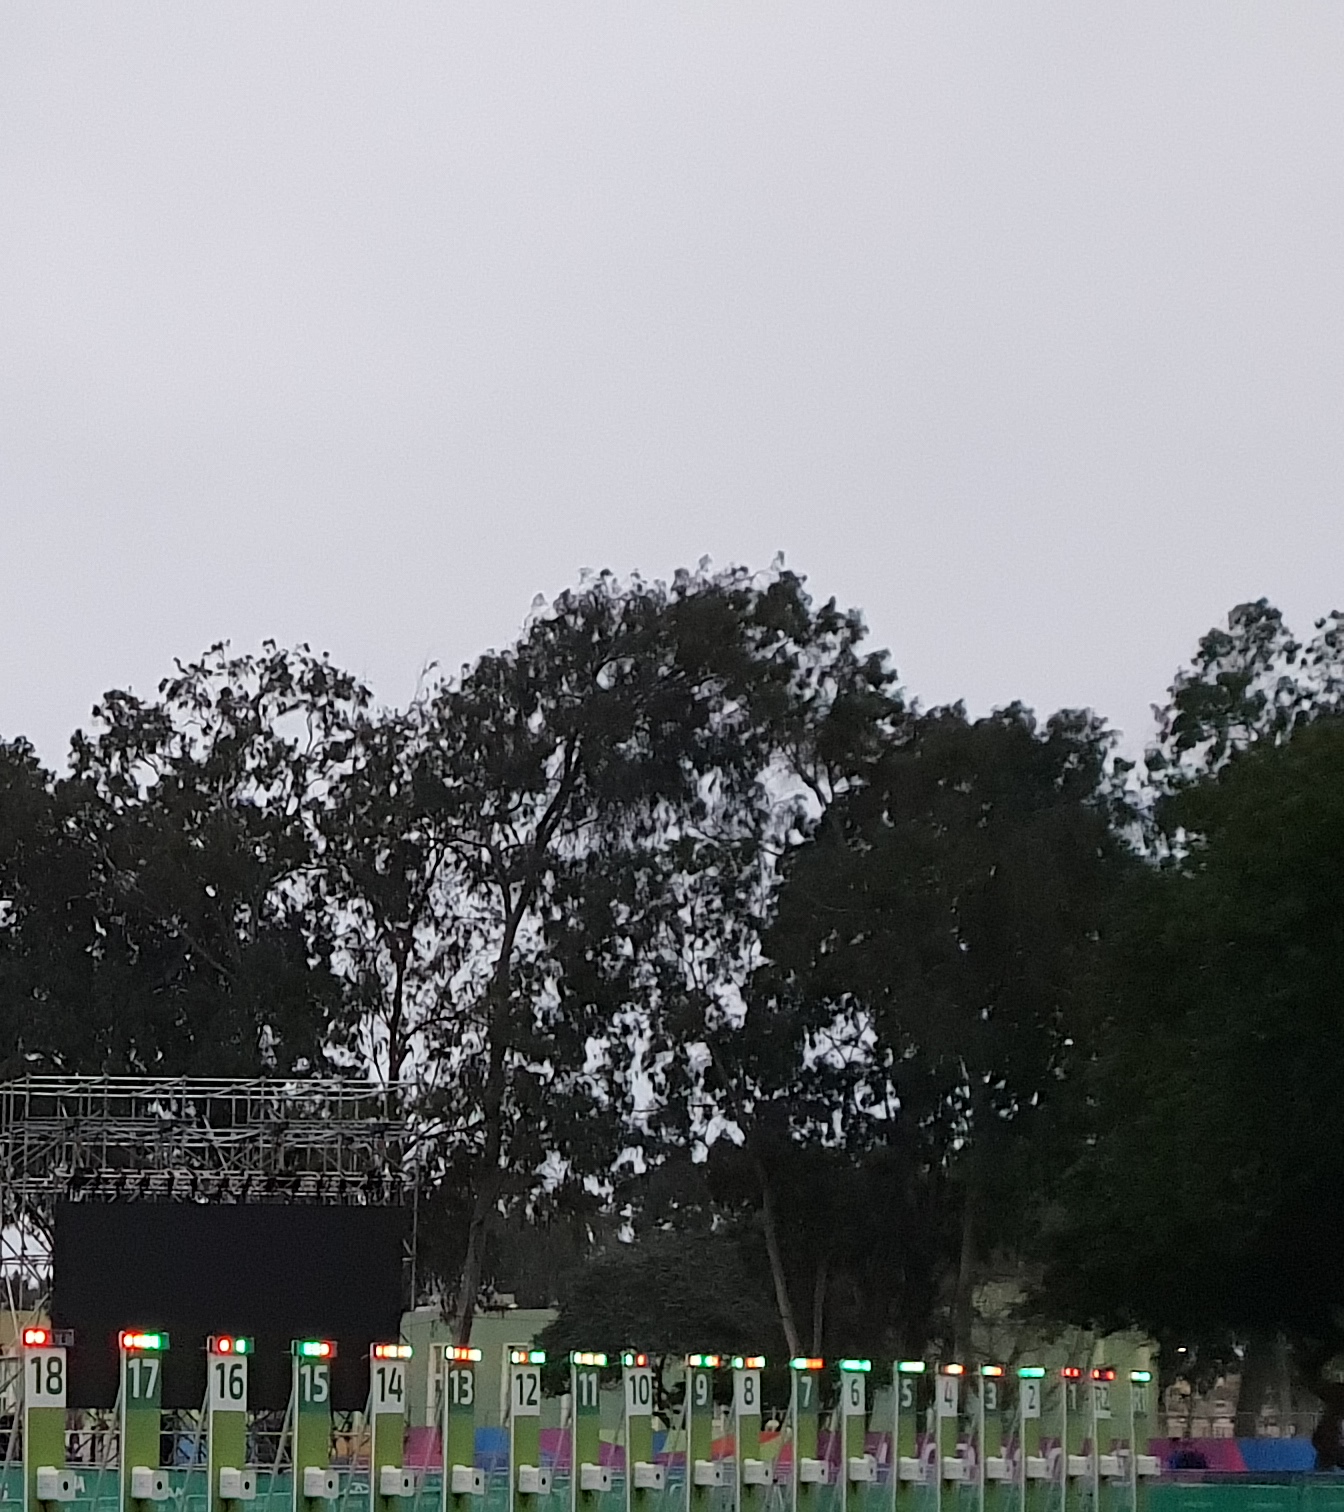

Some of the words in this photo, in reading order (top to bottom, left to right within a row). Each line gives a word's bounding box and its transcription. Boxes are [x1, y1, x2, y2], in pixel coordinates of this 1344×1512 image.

[30, 1355, 63, 1395] 18
[128, 1357, 159, 1399] 17
[215, 1362, 244, 1400] 16
[300, 1365, 328, 1402] 15
[376, 1367, 403, 1403] 14
[450, 1369, 474, 1405] 13
[516, 1373, 538, 1407] 12
[579, 1372, 598, 1407] 11
[629, 1374, 650, 1405] 10
[695, 1373, 708, 1406] 9
[744, 1376, 754, 1406] 8
[801, 1376, 812, 1408] 7
[850, 1376, 860, 1407] 6
[902, 1379, 912, 1408] 5
[944, 1381, 954, 1408] 4
[986, 1381, 997, 1410] 3
[1028, 1385, 1036, 1410] 2
[1069, 1384, 1077, 1411] 1
